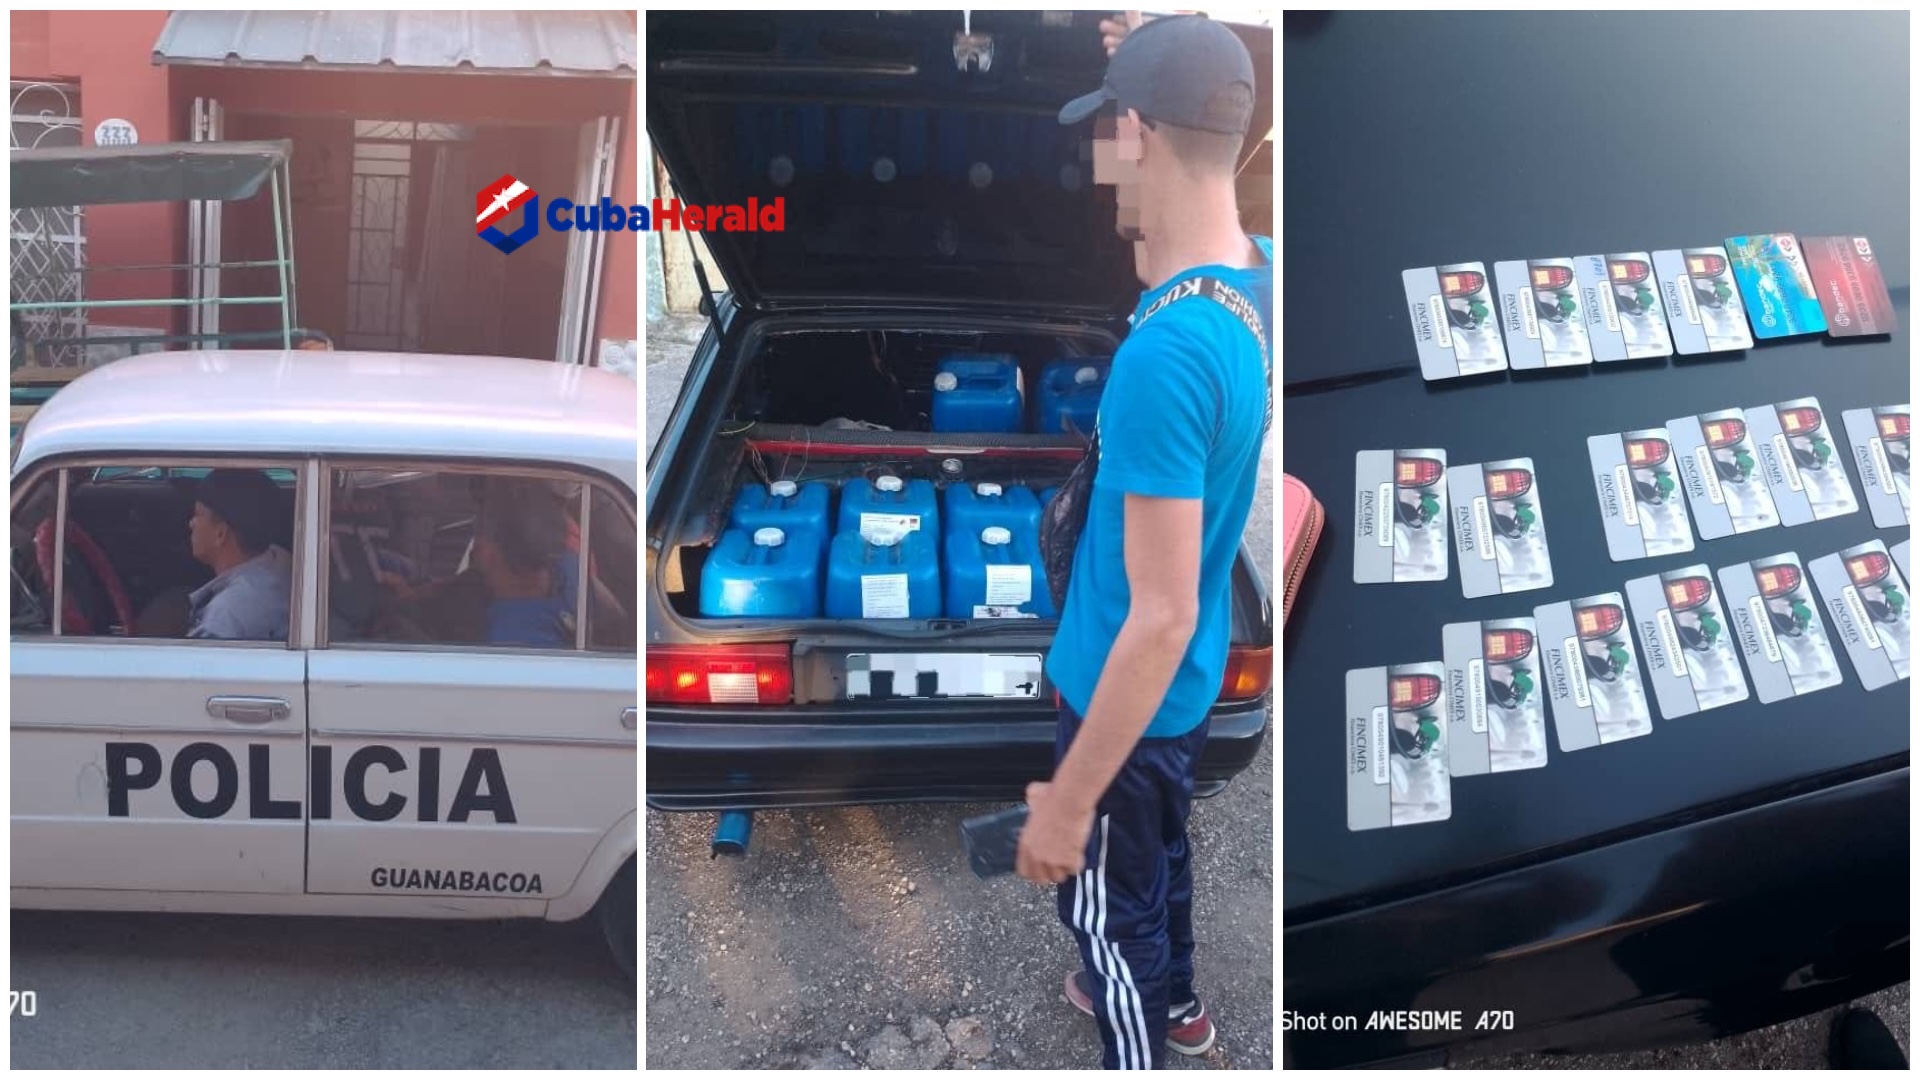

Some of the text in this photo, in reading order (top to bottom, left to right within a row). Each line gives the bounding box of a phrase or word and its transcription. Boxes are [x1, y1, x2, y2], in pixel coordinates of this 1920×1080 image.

[1507, 293, 1521, 331] FINCIMEX
[1588, 287, 1601, 324] FINCIMEX
[1667, 281, 1681, 317] FINCIMEX
[1417, 302, 1432, 341] FINCIMEX
[1685, 455, 1704, 497] FINCIMEX
[1762, 443, 1784, 485] FINCIMEX
[1858, 445, 1877, 487] FINCIMEX
[1363, 490, 1374, 536] FINCIMEX
[1603, 474, 1618, 517] FINCIMEX
[1459, 506, 1474, 552] FINCIMEX
[1737, 607, 1760, 655] FINCIMEX
[1832, 597, 1860, 643] FINCIMEX
[1644, 621, 1665, 669] FINCIMEX
[1454, 669, 1465, 722] FINCIMEX
[1551, 648, 1569, 700] FINCIMEX
[1356, 717, 1367, 774] FINCIMEX
[105, 741, 517, 824] POLICIA
[370, 866, 543, 895] GUANABACOA
